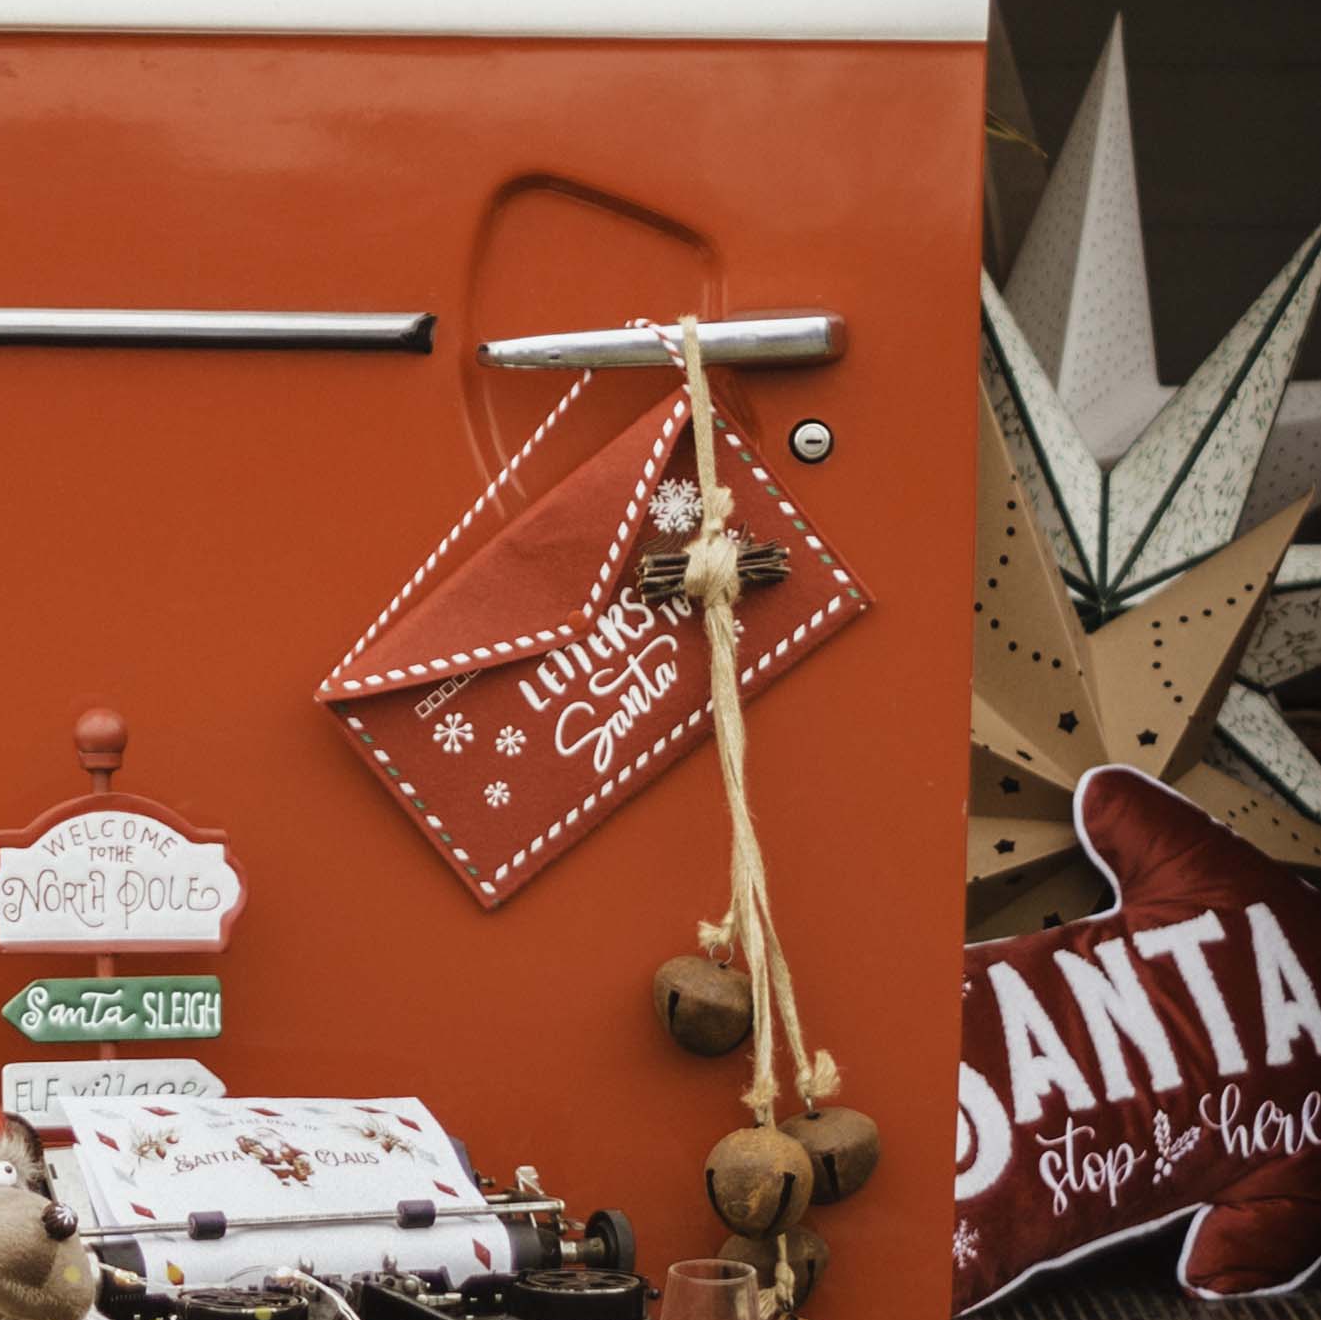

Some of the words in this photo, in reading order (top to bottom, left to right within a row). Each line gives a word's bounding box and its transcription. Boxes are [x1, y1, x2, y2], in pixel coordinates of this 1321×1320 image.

[518, 585, 656, 712] LETTERS
[555, 634, 678, 773] Santa
[41, 819, 178, 857] WELCOME
[108, 845, 137, 863] THE
[1, 869, 105, 928] NORTH
[116, 869, 221, 930] POLE
[20, 986, 137, 1030] Santa
[142, 991, 221, 1030] SLEIGH
[15, 1077, 60, 1113] ELF
[171, 1150, 245, 1177] SANTA
[314, 1148, 381, 1168] CLAUS
[1035, 1116, 1147, 1216] stop
[1199, 1083, 1321, 1159] here
